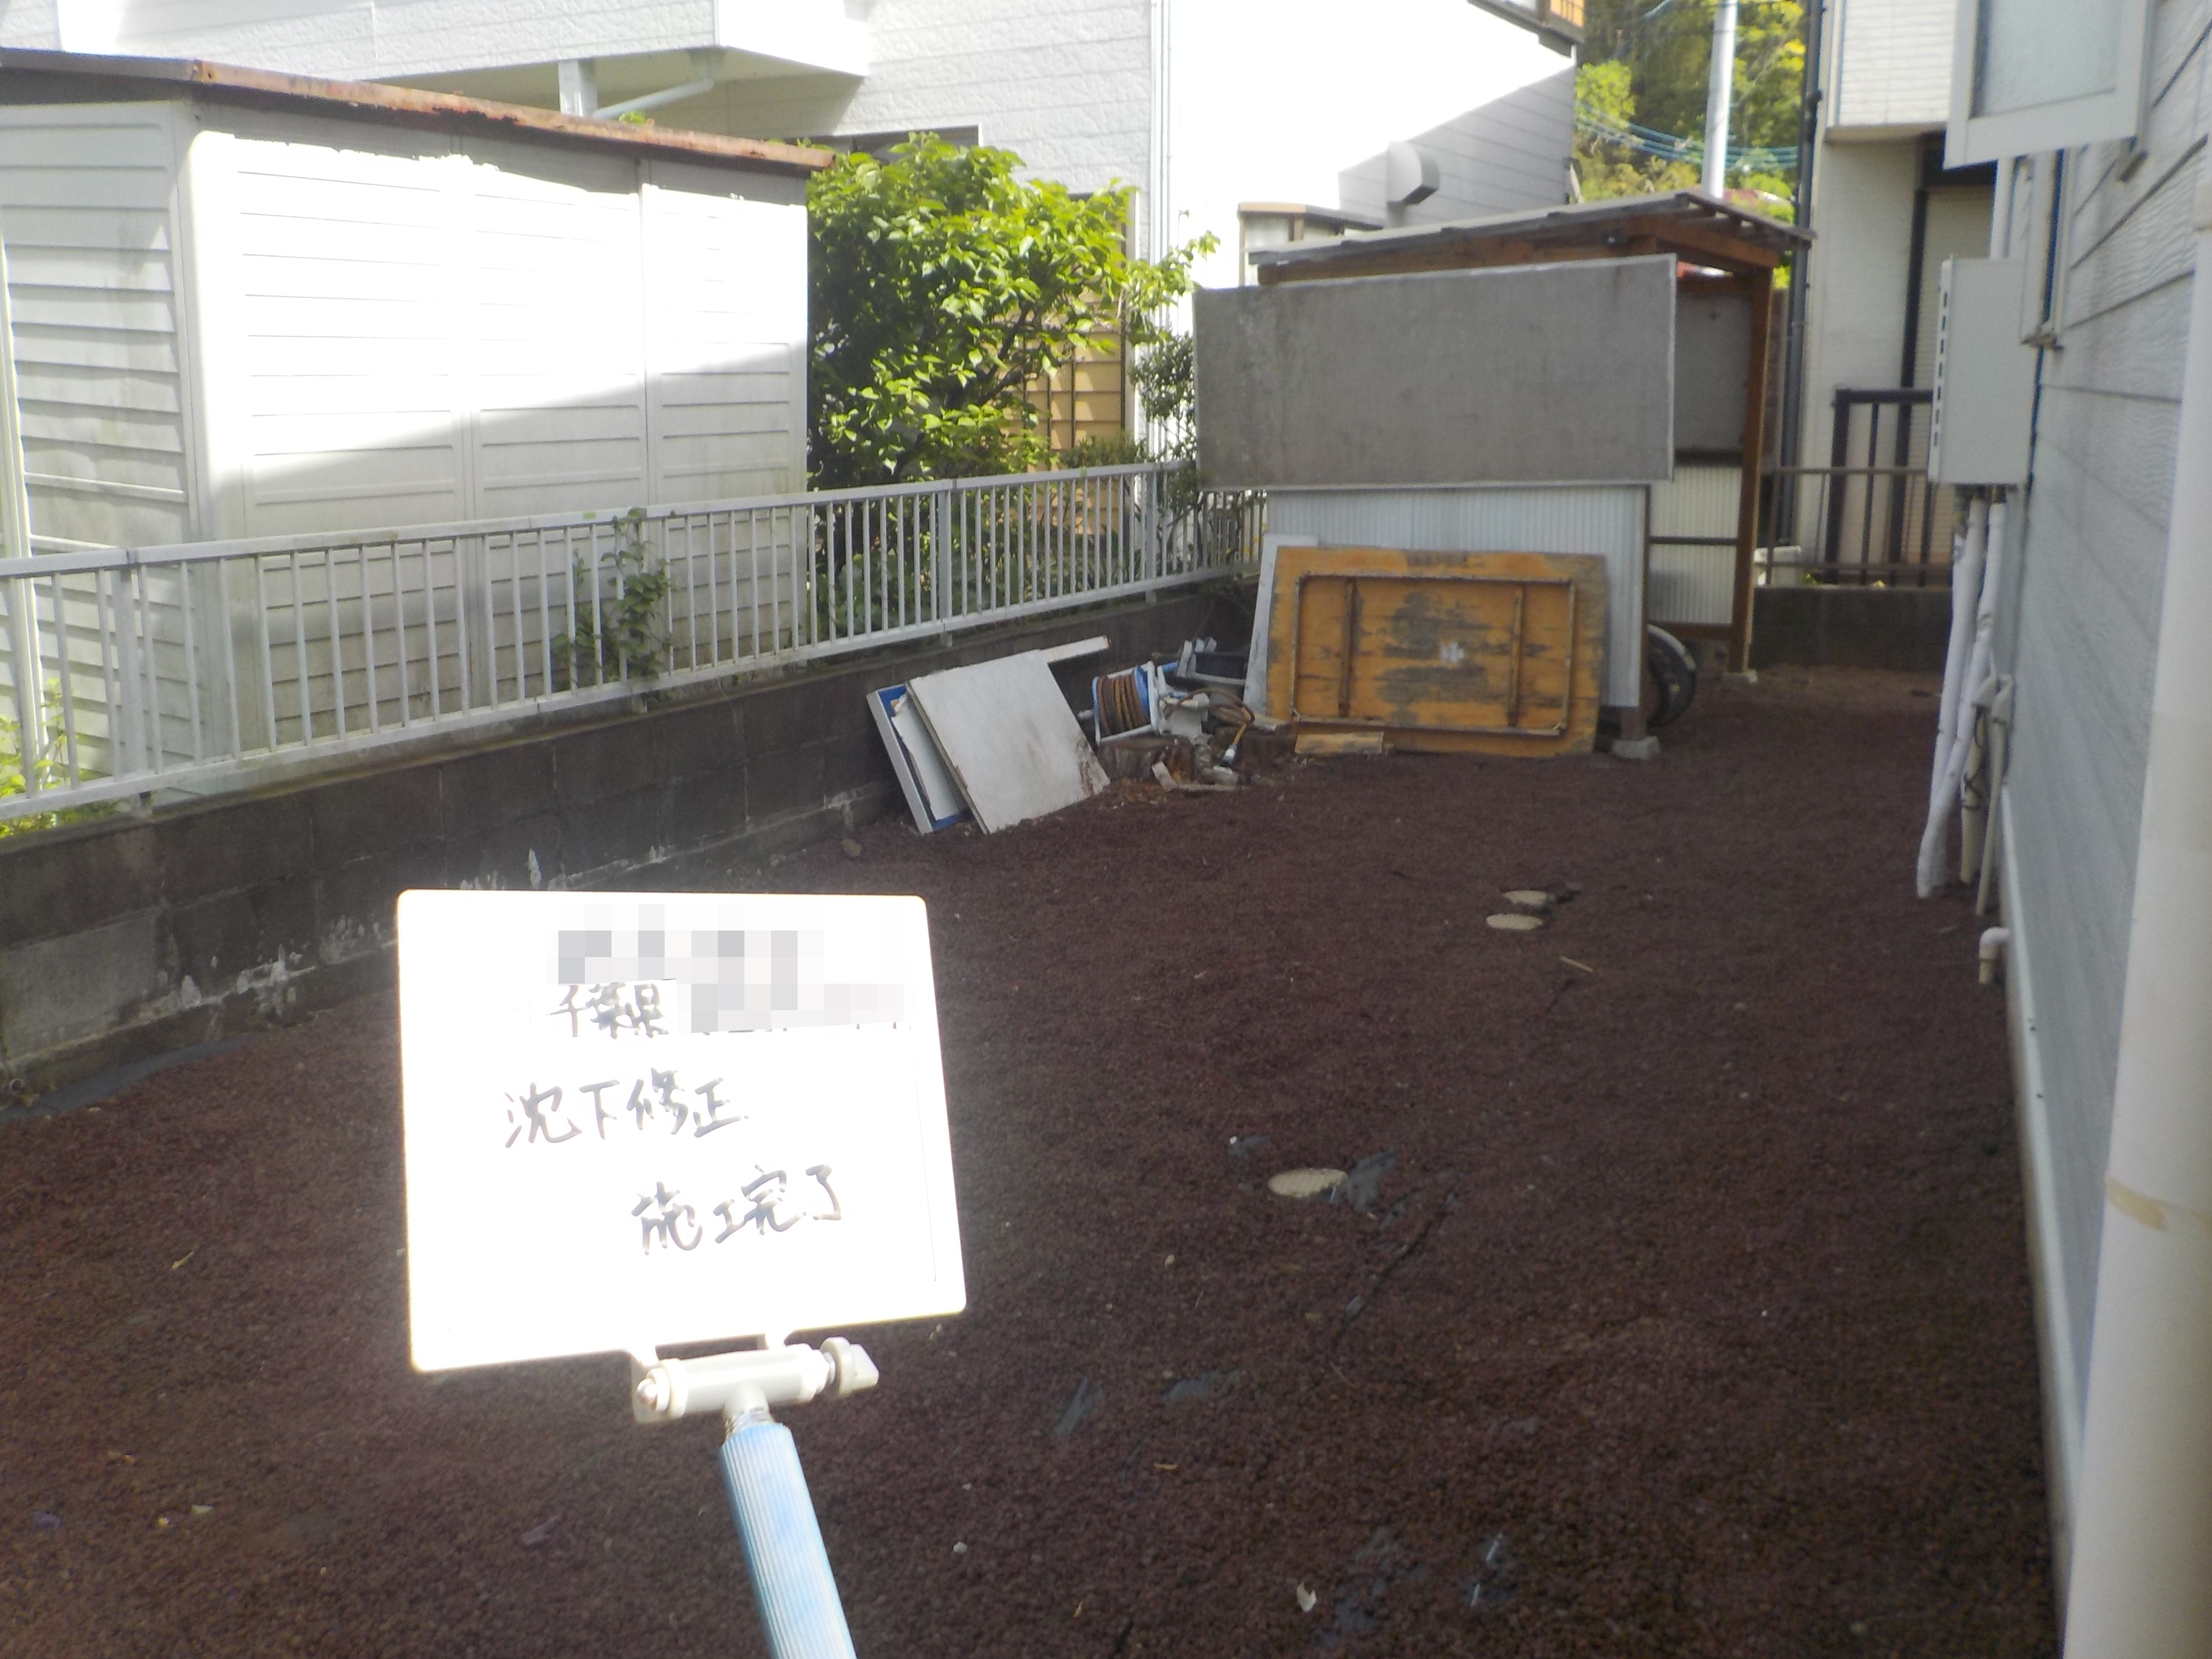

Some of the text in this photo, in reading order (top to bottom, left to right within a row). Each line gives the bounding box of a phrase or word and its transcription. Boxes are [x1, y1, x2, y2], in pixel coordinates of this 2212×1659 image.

[504, 1067, 747, 1149] 沈下修正
[631, 1164, 842, 1255] 施工完了
